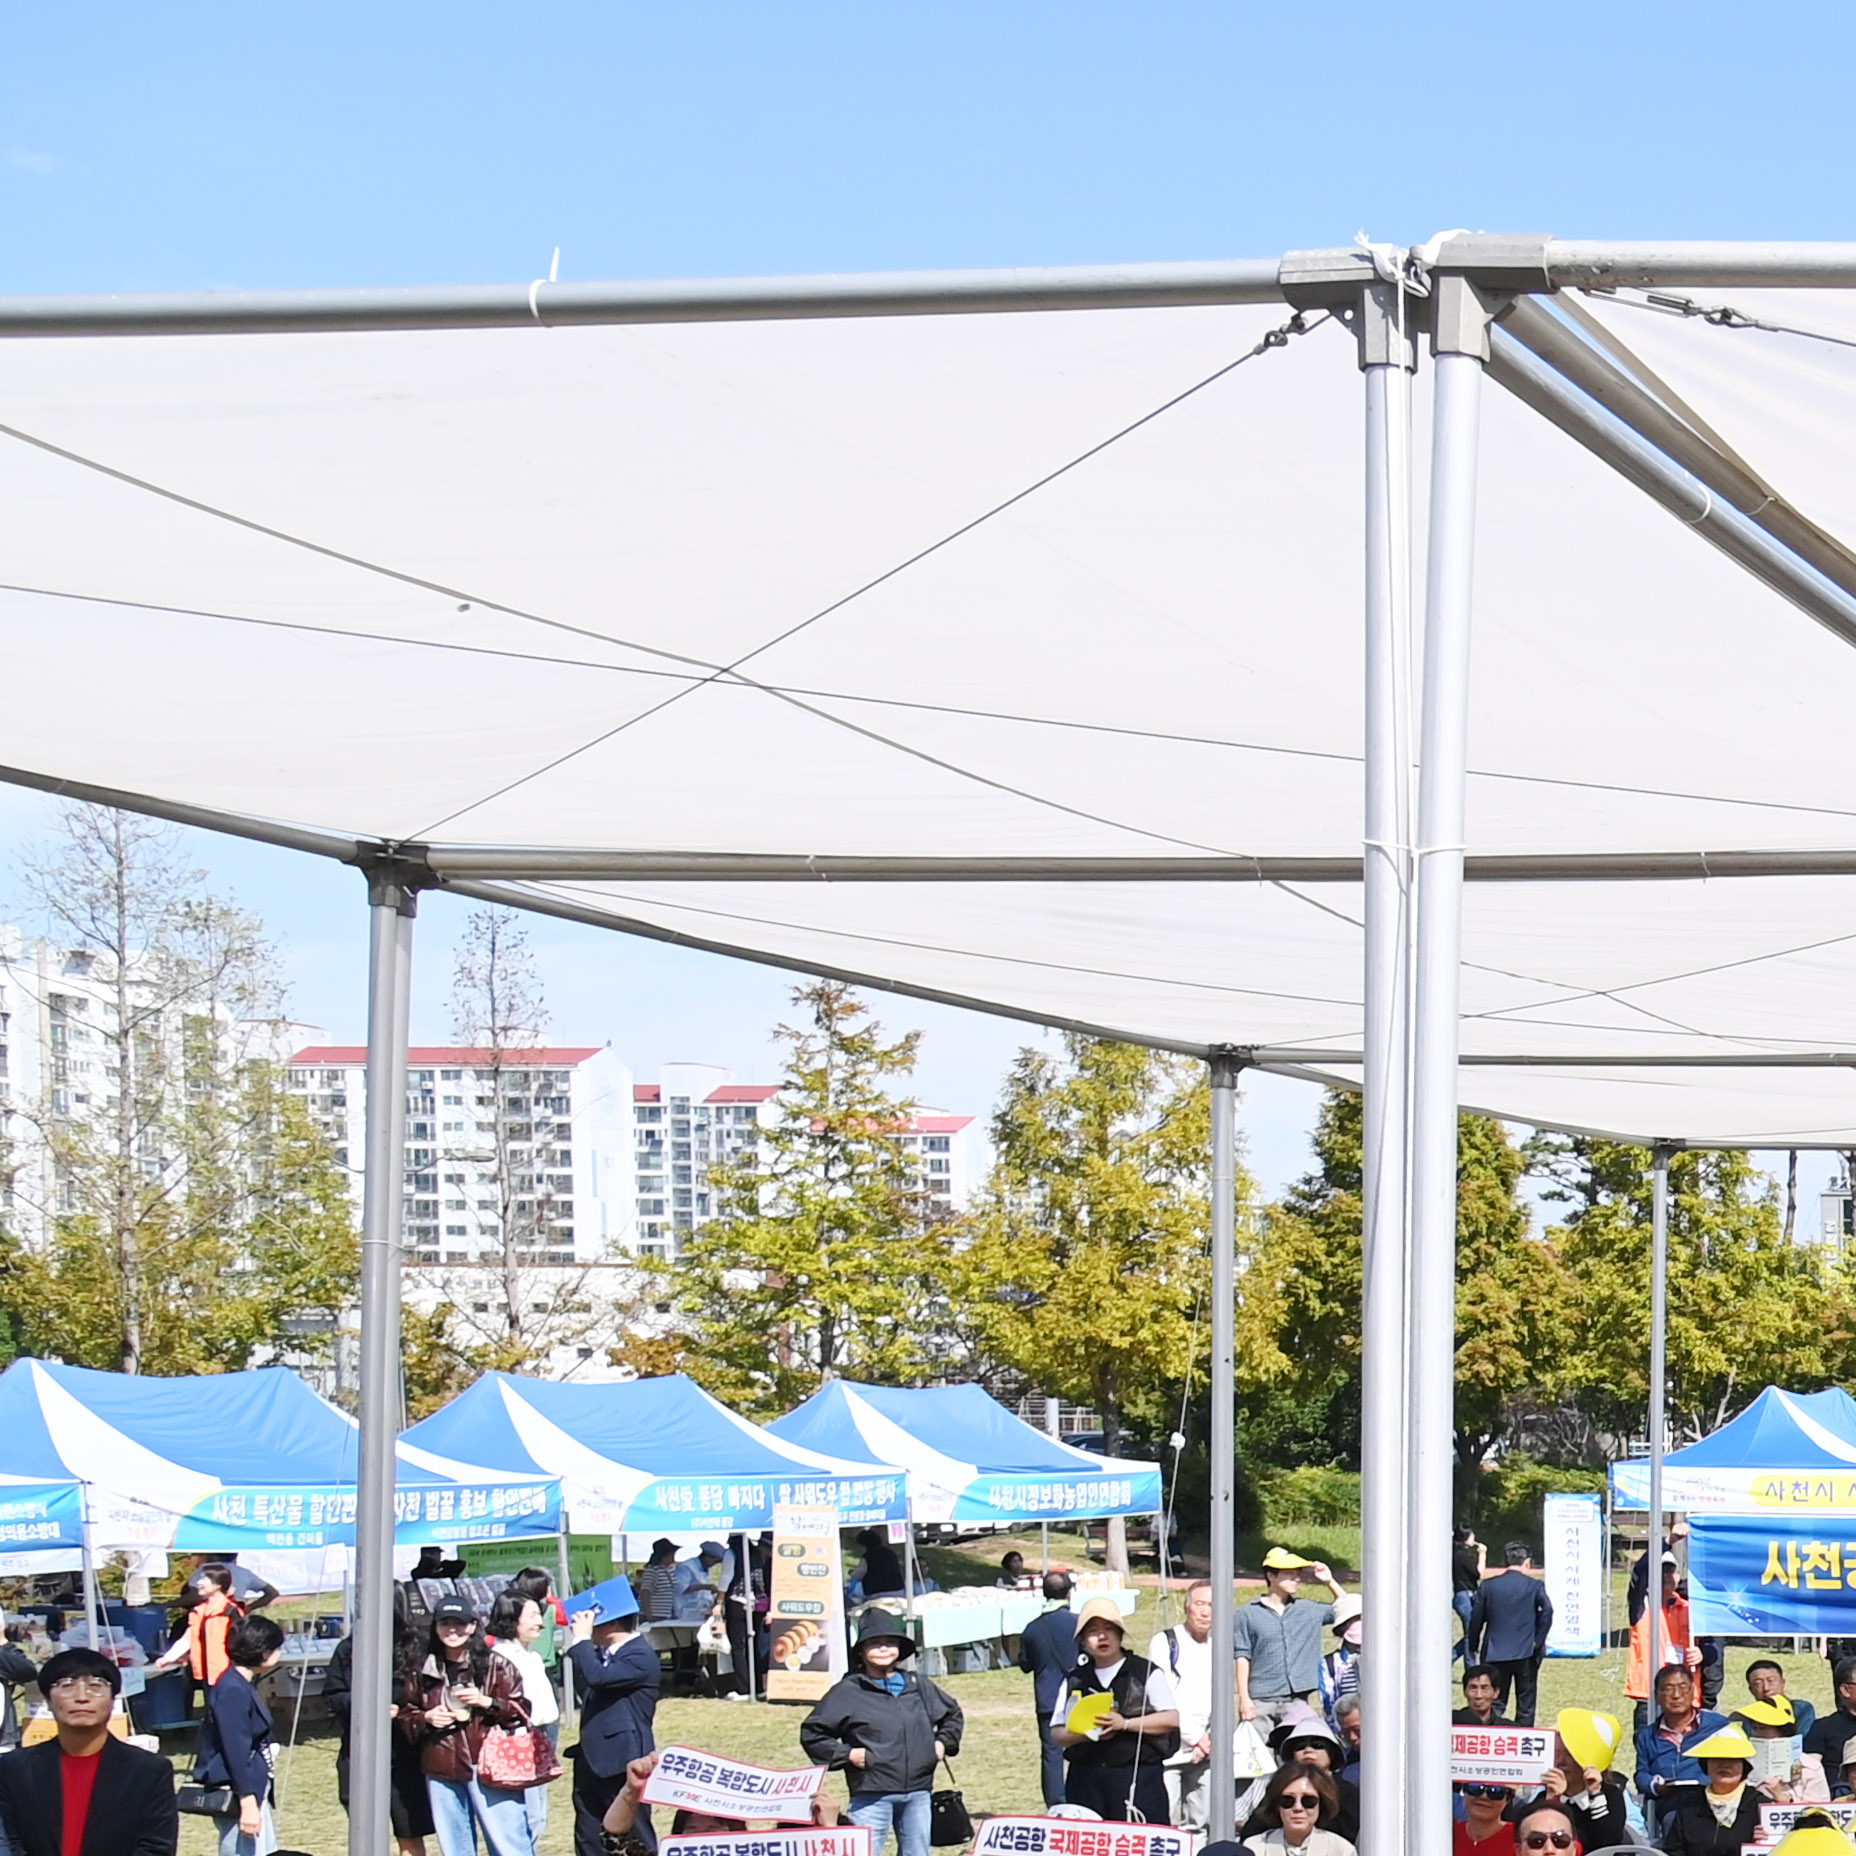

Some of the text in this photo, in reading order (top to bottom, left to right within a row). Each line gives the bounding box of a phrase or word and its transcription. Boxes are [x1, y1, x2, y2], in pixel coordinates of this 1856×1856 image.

[426, 1491, 455, 1522] 벌꿀
[459, 1489, 487, 1521] 홍보
[1765, 1481, 1834, 1504] 사천시
[212, 1494, 356, 1526] 사천 특산물 할인판
[660, 1753, 812, 1794] 우주항공 복합도시 사천시
